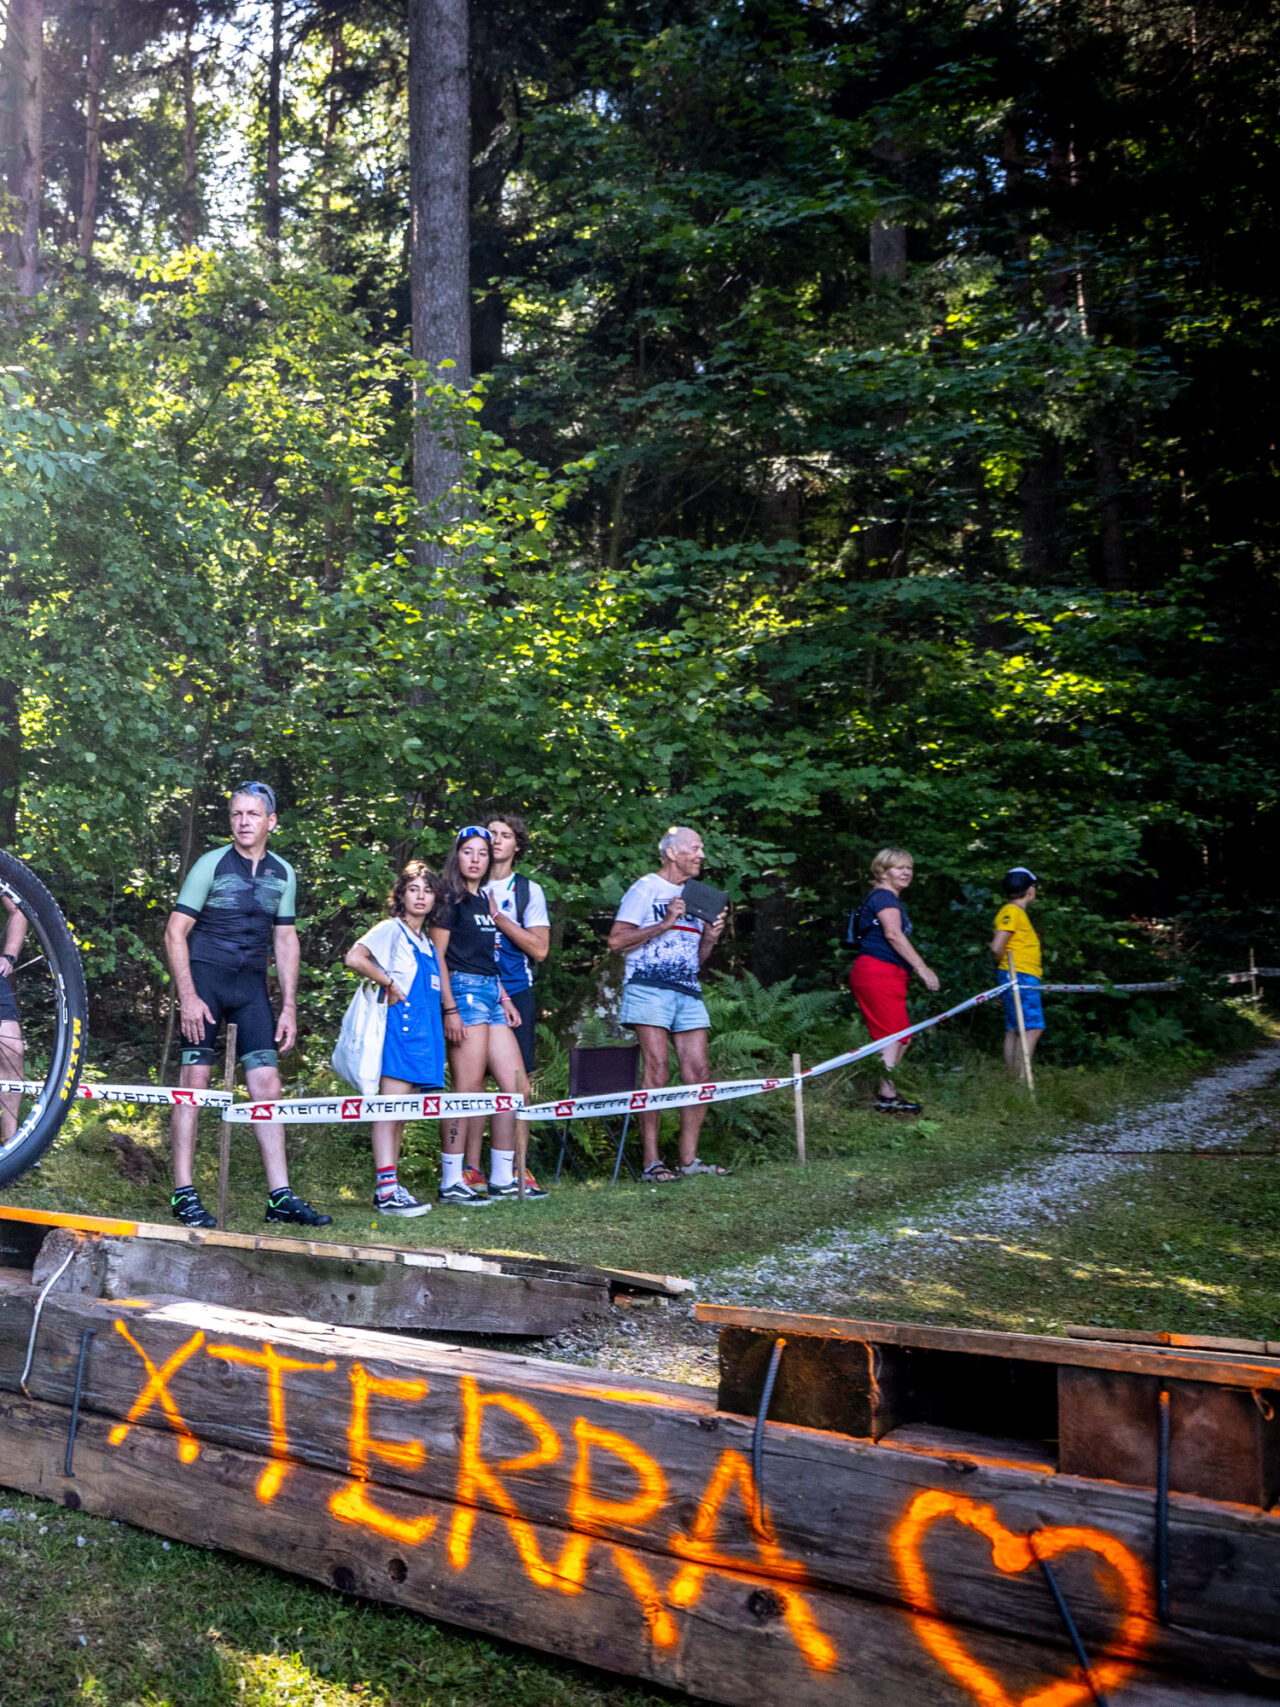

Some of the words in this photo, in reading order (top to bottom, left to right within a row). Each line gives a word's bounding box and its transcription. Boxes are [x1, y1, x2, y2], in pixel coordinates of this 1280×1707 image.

[60, 1017, 81, 1101] MAXXIS
[98, 1091, 170, 1104] XTERRA
[278, 1104, 338, 1115] XTERRA
[365, 1101, 419, 1114] XTERRA
[445, 1099, 494, 1111] XTERRA
[576, 1098, 628, 1111] XTERRA
[650, 1090, 698, 1104] XTERRA
[108, 1318, 840, 1674] XTERRA
